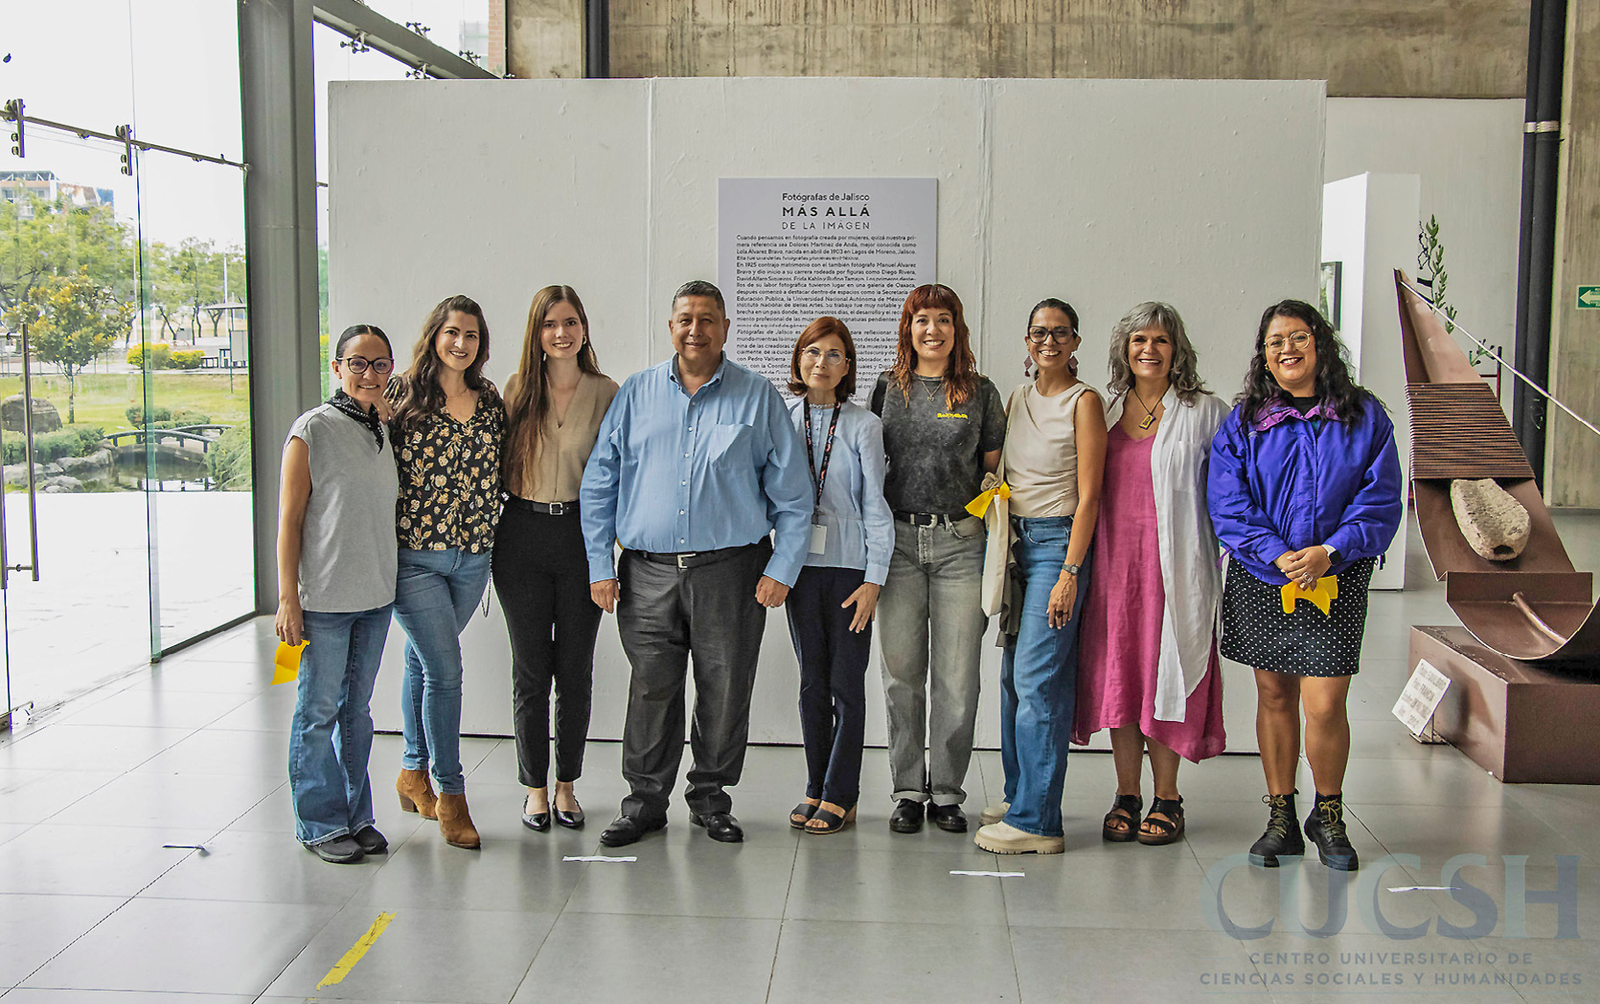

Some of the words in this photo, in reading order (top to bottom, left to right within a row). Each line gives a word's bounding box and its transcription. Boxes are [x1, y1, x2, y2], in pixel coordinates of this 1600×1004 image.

[782, 192, 828, 202] Fotógrafas
[829, 192, 840, 201] de
[841, 192, 870, 201] Jalisco
[782, 204, 818, 216] MÁS
[825, 204, 870, 216] ALLÁ
[782, 222, 796, 230] DE
[803, 222, 816, 230] LA
